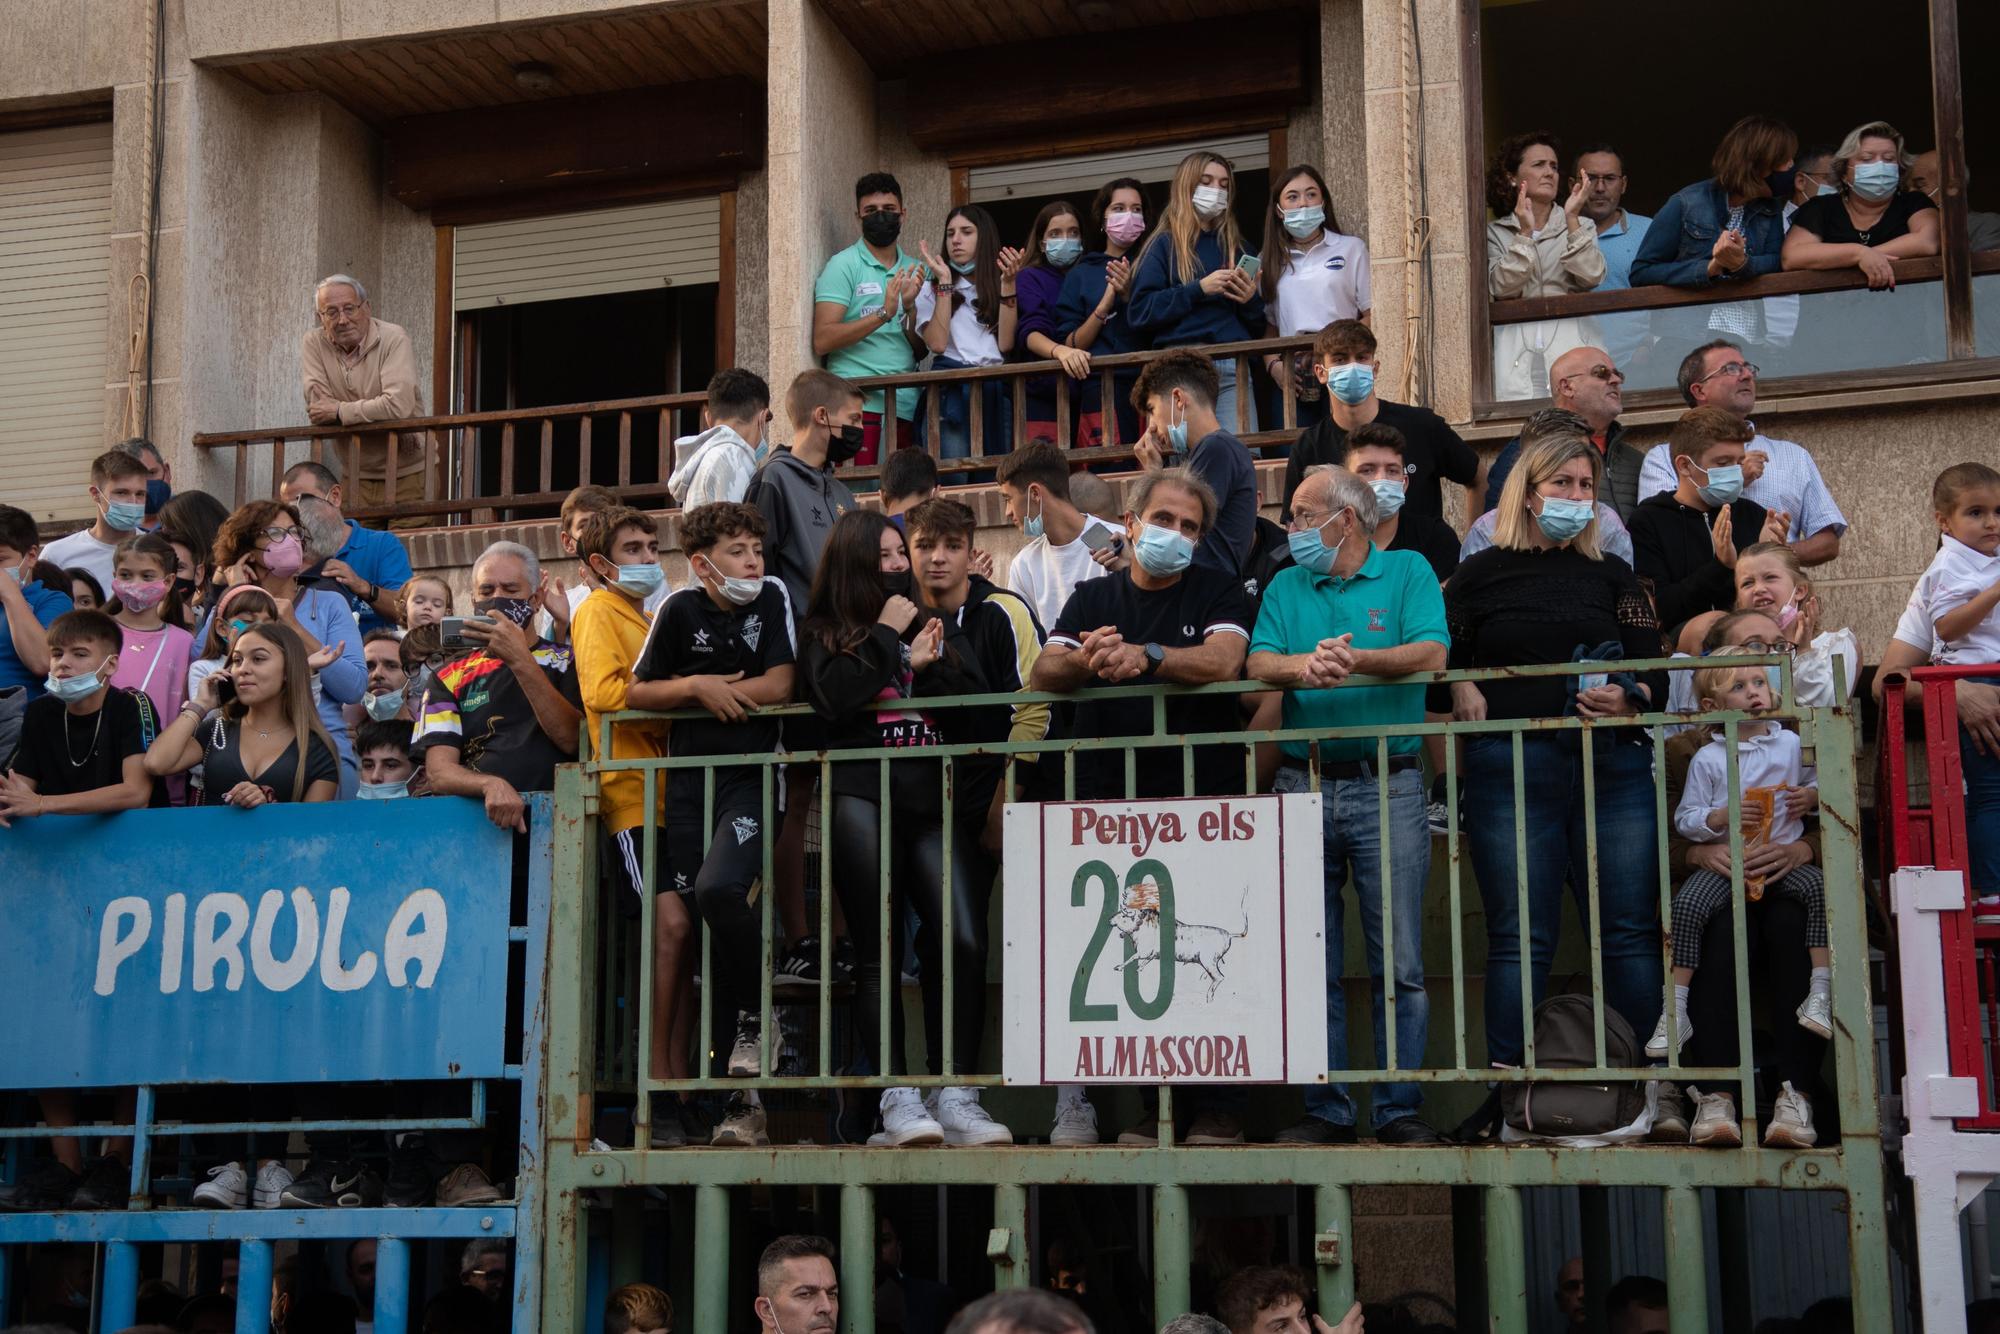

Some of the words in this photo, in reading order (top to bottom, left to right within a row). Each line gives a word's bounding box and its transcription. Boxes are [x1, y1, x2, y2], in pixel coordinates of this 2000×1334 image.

[1070, 807, 1187, 858] Penya
[1197, 802, 1256, 841] els
[94, 886, 448, 997] PIRULA
[1069, 858, 1176, 1022] 20
[1074, 1035, 1252, 1078] ALMASSORA
